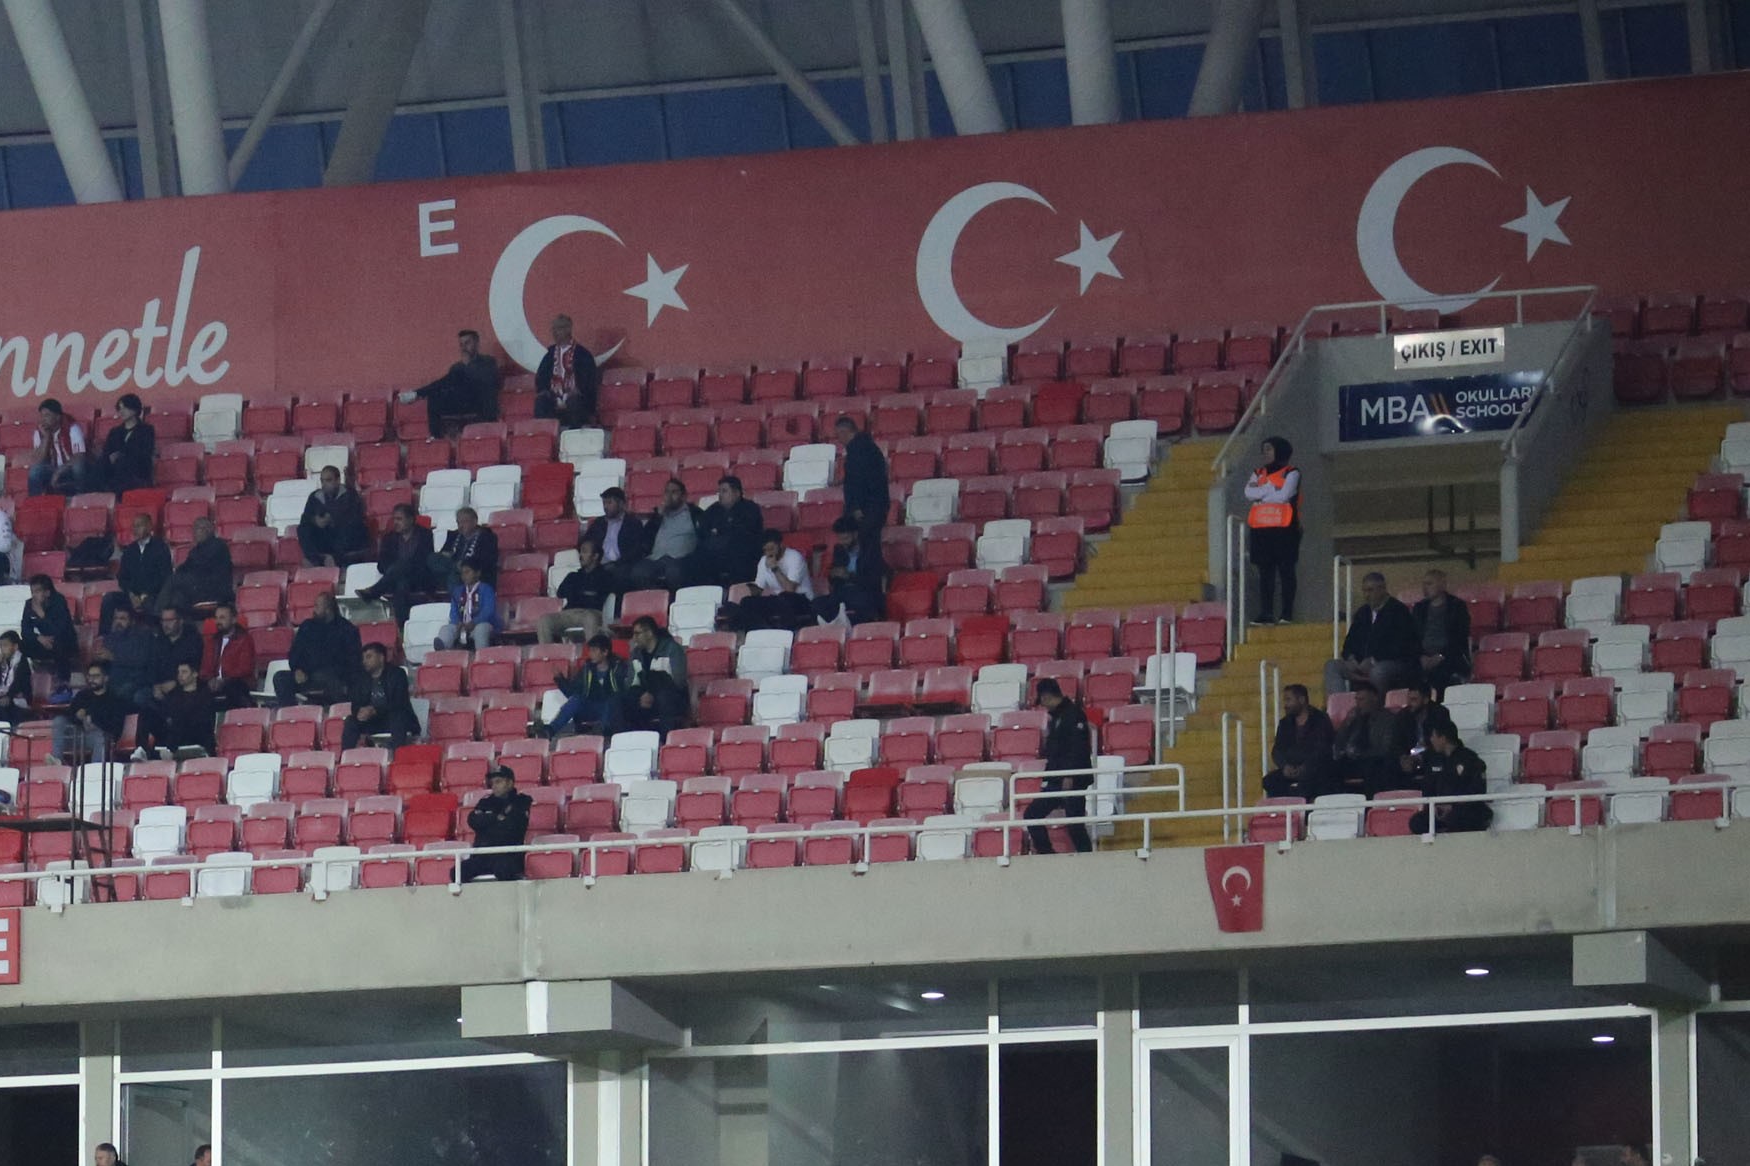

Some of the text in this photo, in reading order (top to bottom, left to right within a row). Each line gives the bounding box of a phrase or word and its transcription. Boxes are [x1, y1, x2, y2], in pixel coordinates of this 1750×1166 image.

[419, 199, 459, 257] E
[1400, 341, 1446, 363] ÇIKIŞ
[1460, 337, 1498, 356] EXIT
[1360, 394, 1431, 426] MBA
